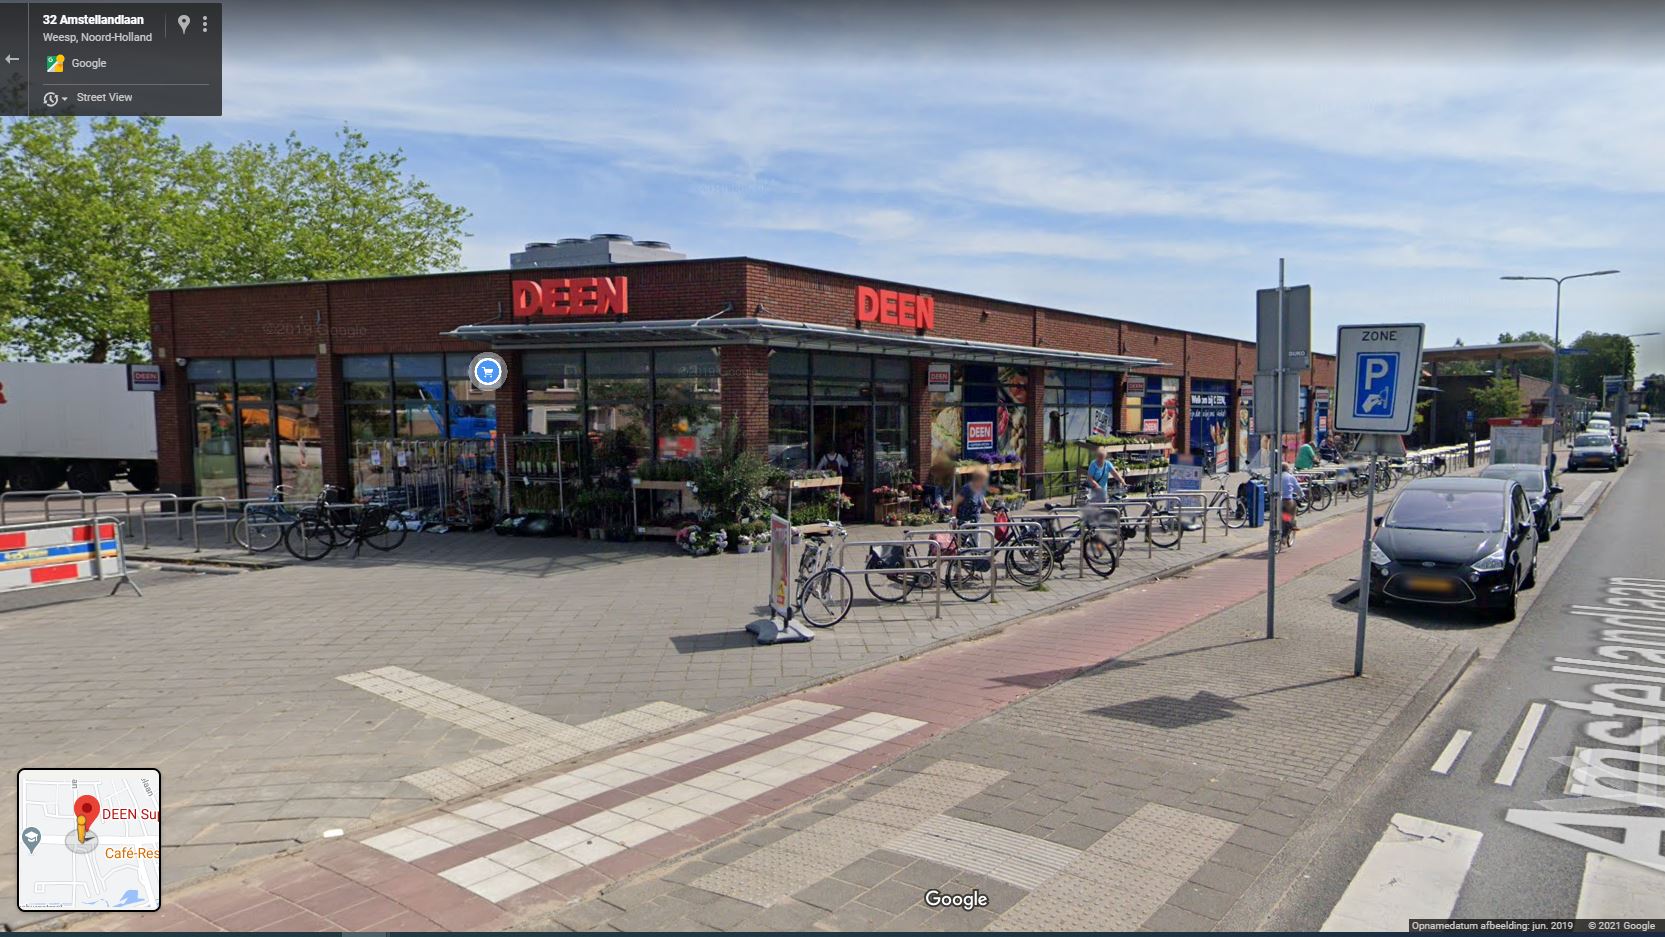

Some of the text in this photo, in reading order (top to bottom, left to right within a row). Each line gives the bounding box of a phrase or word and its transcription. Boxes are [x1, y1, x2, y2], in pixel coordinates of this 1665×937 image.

[512, 276, 628, 317] DEEN
[855, 285, 934, 329] DEEN
[1362, 330, 1398, 342] ZONE
[1364, 358, 1389, 390] P
[969, 426, 991, 438] DEEN
